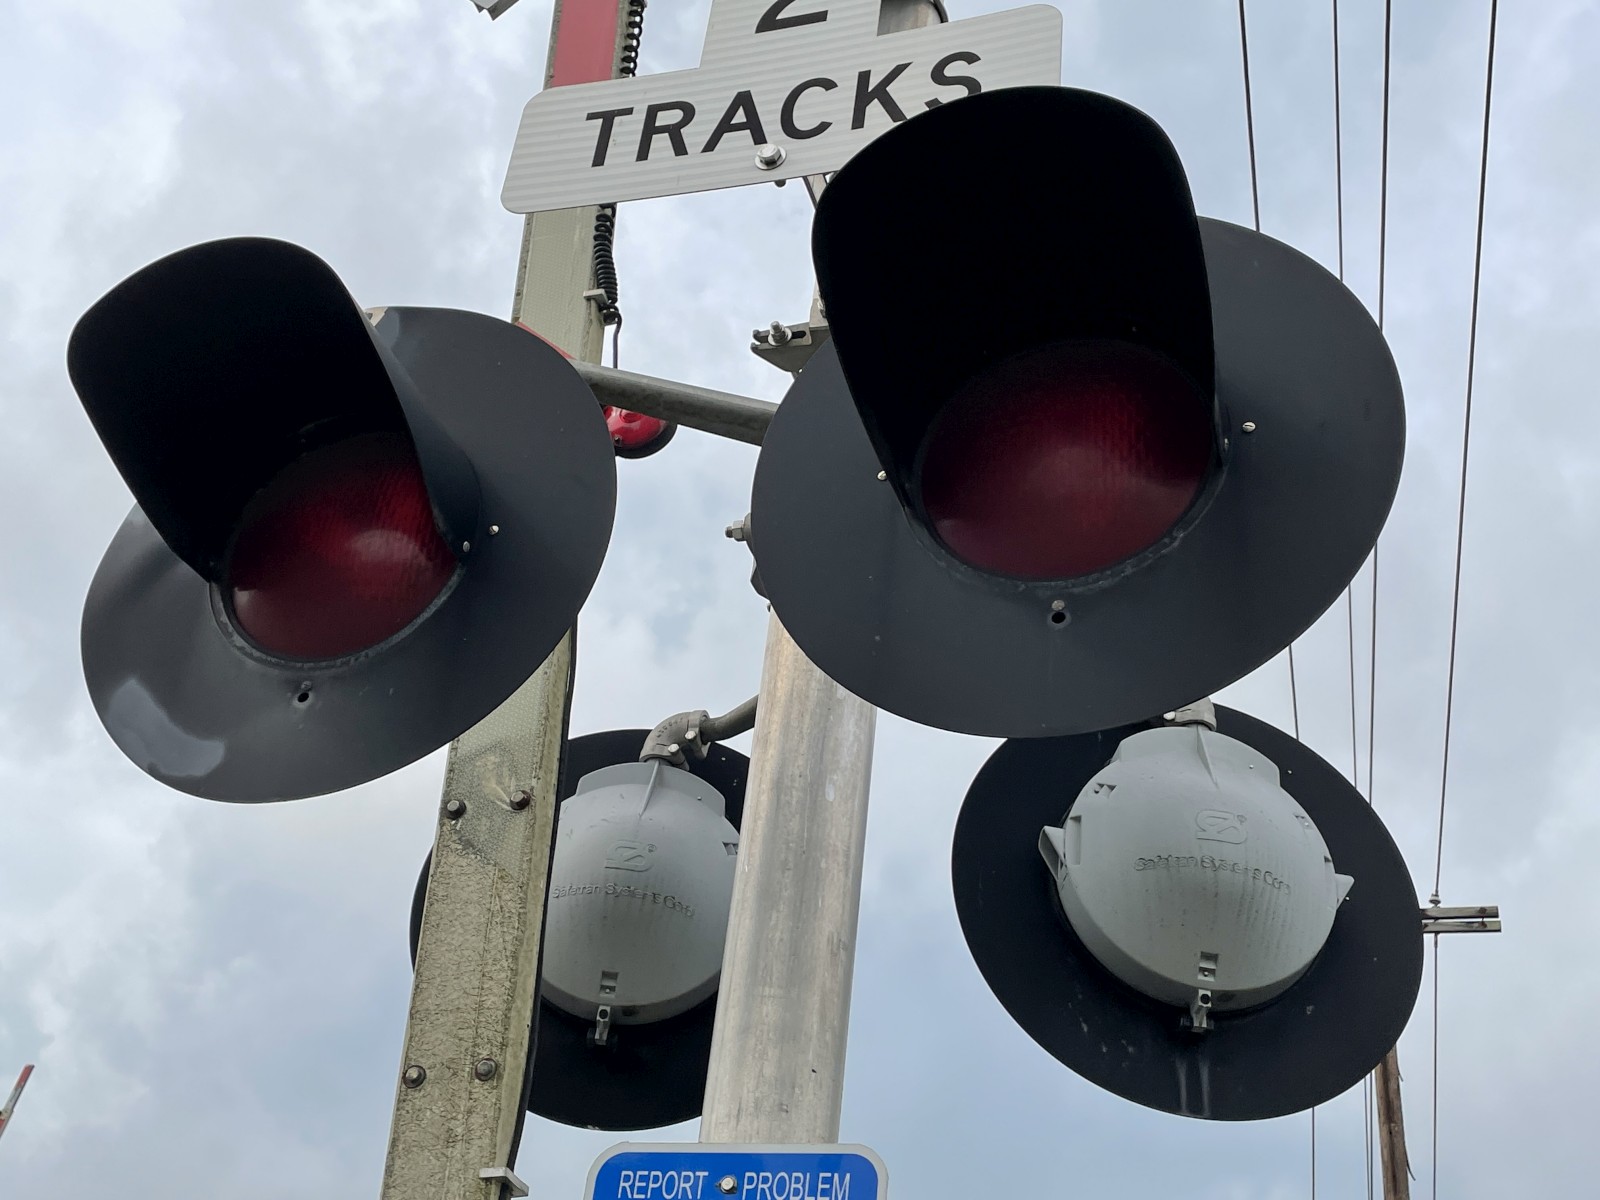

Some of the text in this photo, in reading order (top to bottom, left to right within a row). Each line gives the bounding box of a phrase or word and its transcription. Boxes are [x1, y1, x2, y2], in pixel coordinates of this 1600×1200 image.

[585, 50, 982, 168] TRACKS
[1200, 854, 1262, 881] Systes
[552, 883, 601, 899] Safetran
[617, 1170, 851, 1200] REPORT PROBLEM
